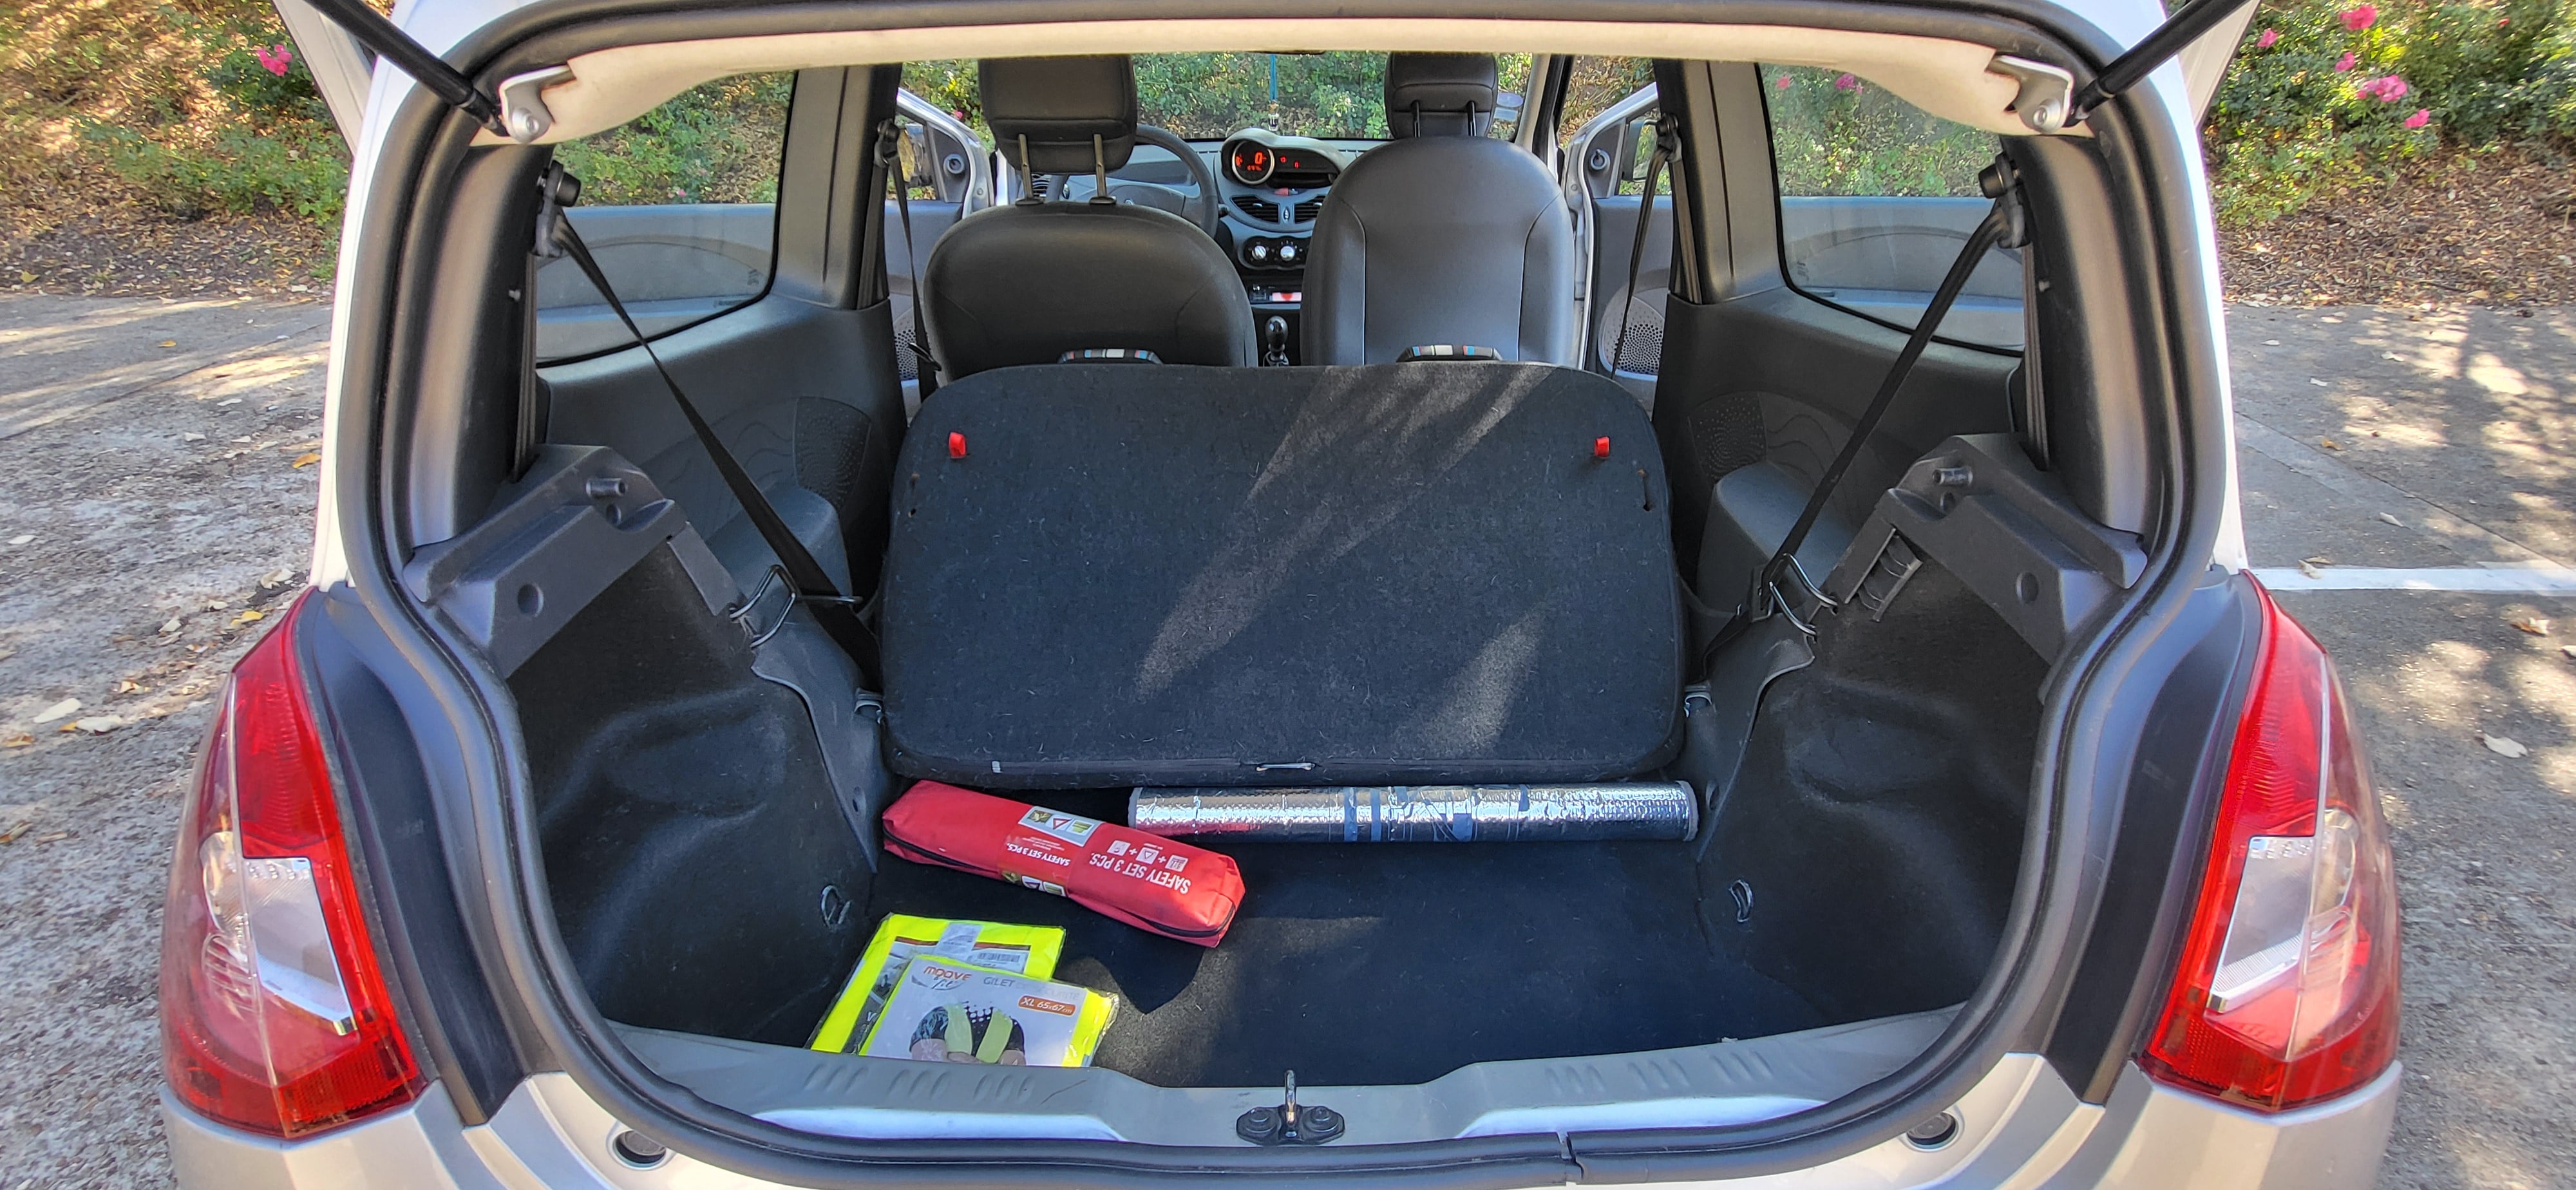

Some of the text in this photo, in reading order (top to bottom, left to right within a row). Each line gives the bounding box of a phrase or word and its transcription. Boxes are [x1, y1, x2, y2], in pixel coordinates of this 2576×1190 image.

[1027, 849, 1042, 859] SET
[1041, 853, 1070, 866] SAFETY
[1089, 853, 1191, 894] SAFETY SET 3 PCS.
[983, 977, 1015, 987] GILET
[1021, 997, 1035, 1006] XL
